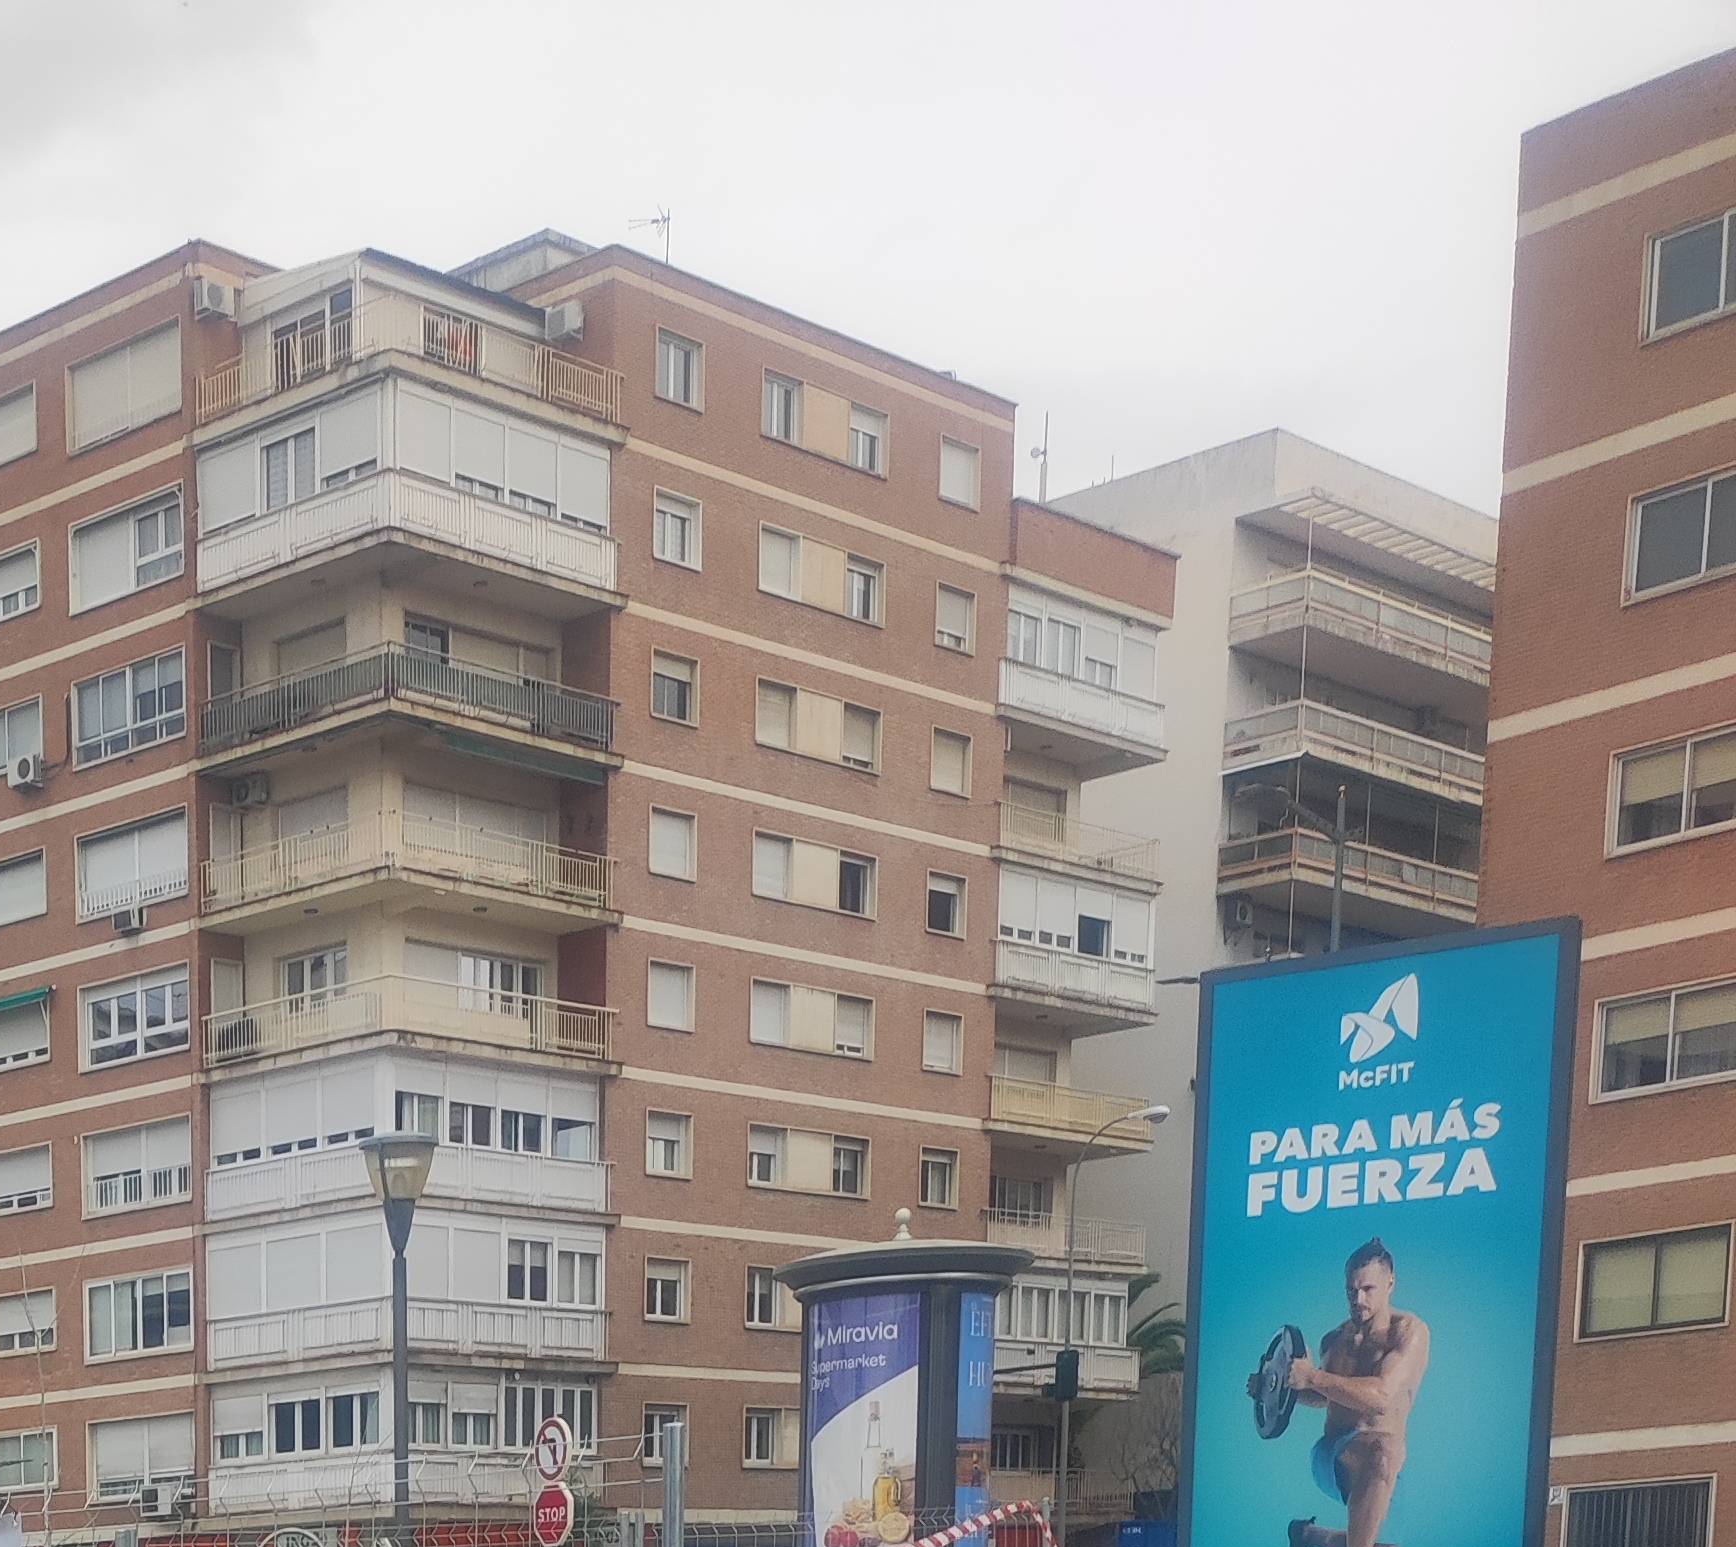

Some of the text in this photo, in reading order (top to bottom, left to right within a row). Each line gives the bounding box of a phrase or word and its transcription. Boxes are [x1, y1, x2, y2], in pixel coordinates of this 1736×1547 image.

[1338, 1061, 1415, 1091] McFIT
[1249, 1097, 1502, 1166] PARA MÁS
[1246, 1146, 1497, 1218] FUERZA
[827, 1321, 899, 1347] Miravia
[811, 1353, 887, 1377] Supermarket
[811, 1377, 831, 1392] Days
[538, 1505, 566, 1522] STOP
